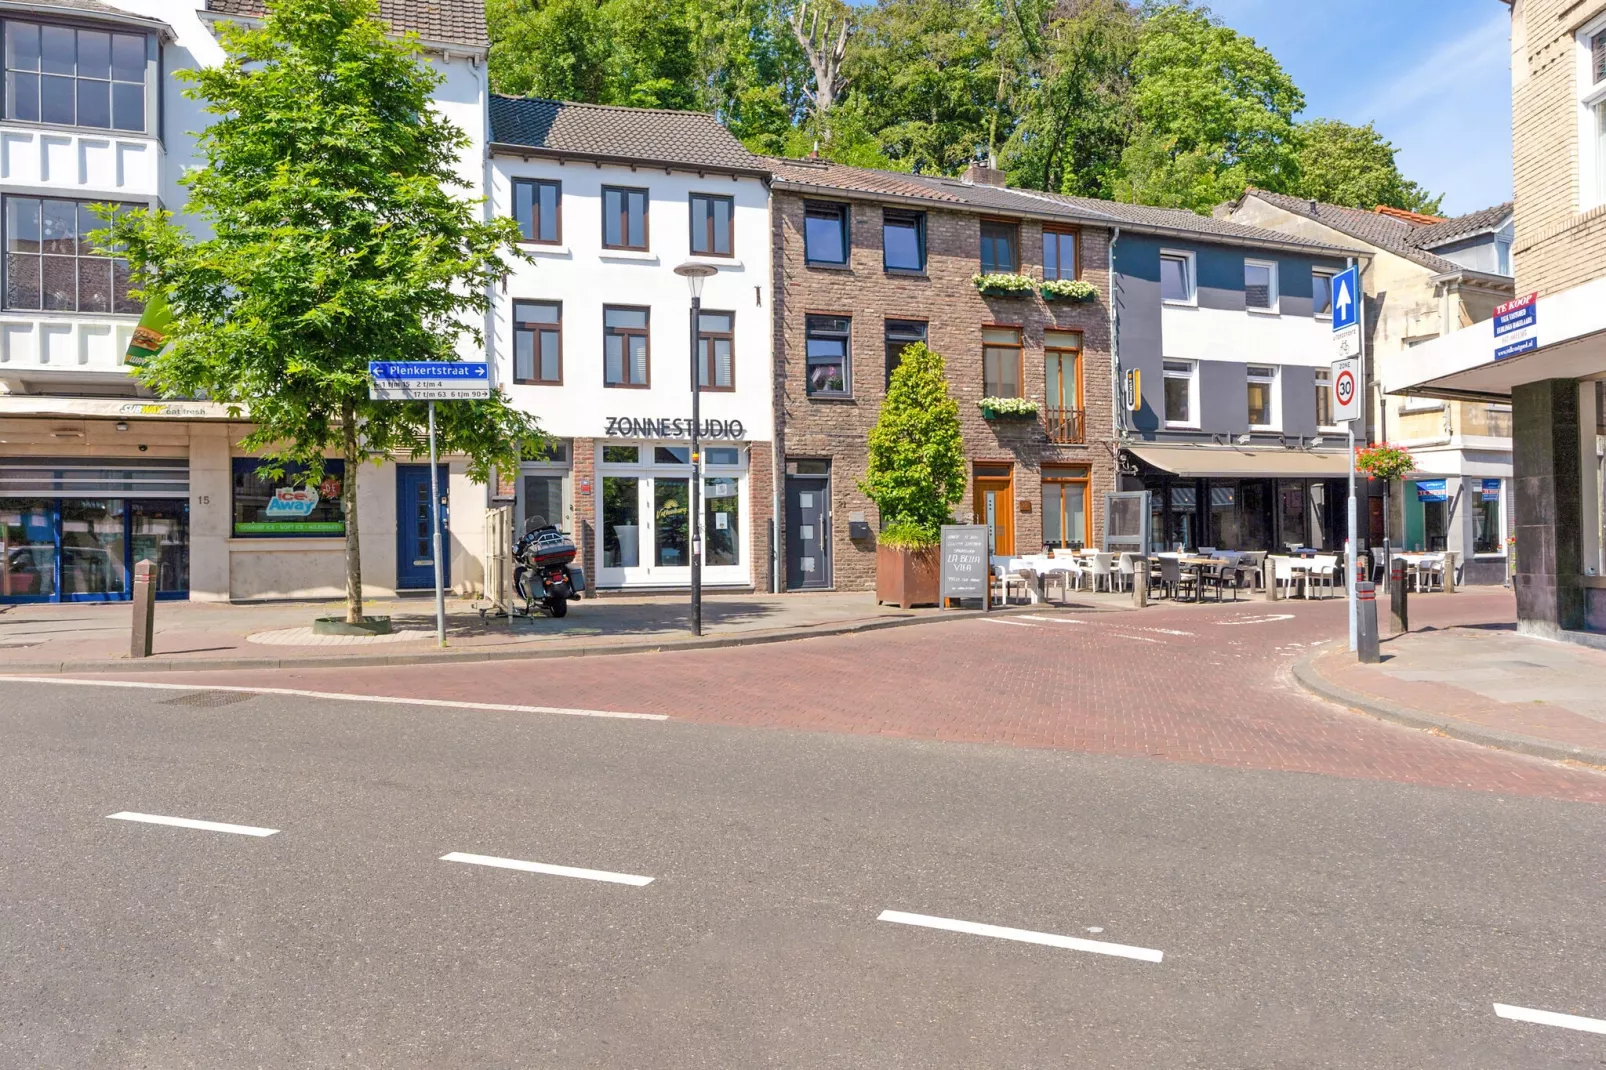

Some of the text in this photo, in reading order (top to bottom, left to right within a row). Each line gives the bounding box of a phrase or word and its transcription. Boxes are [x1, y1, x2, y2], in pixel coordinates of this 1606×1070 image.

[1496, 295, 1533, 315] TE KOOP
[390, 365, 469, 375] Plenkertstraat
[1339, 361, 1351, 370] ZONE
[423, 381, 436, 389] t/m
[1339, 381, 1351, 396] 30
[423, 391, 436, 399] t/m
[457, 391, 470, 399] t/m
[120, 403, 167, 415] SUBWAY
[166, 408, 180, 416] eat
[605, 416, 744, 438] ZONNESTUDIO
[198, 496, 210, 505] 15
[269, 497, 316, 515] Away
